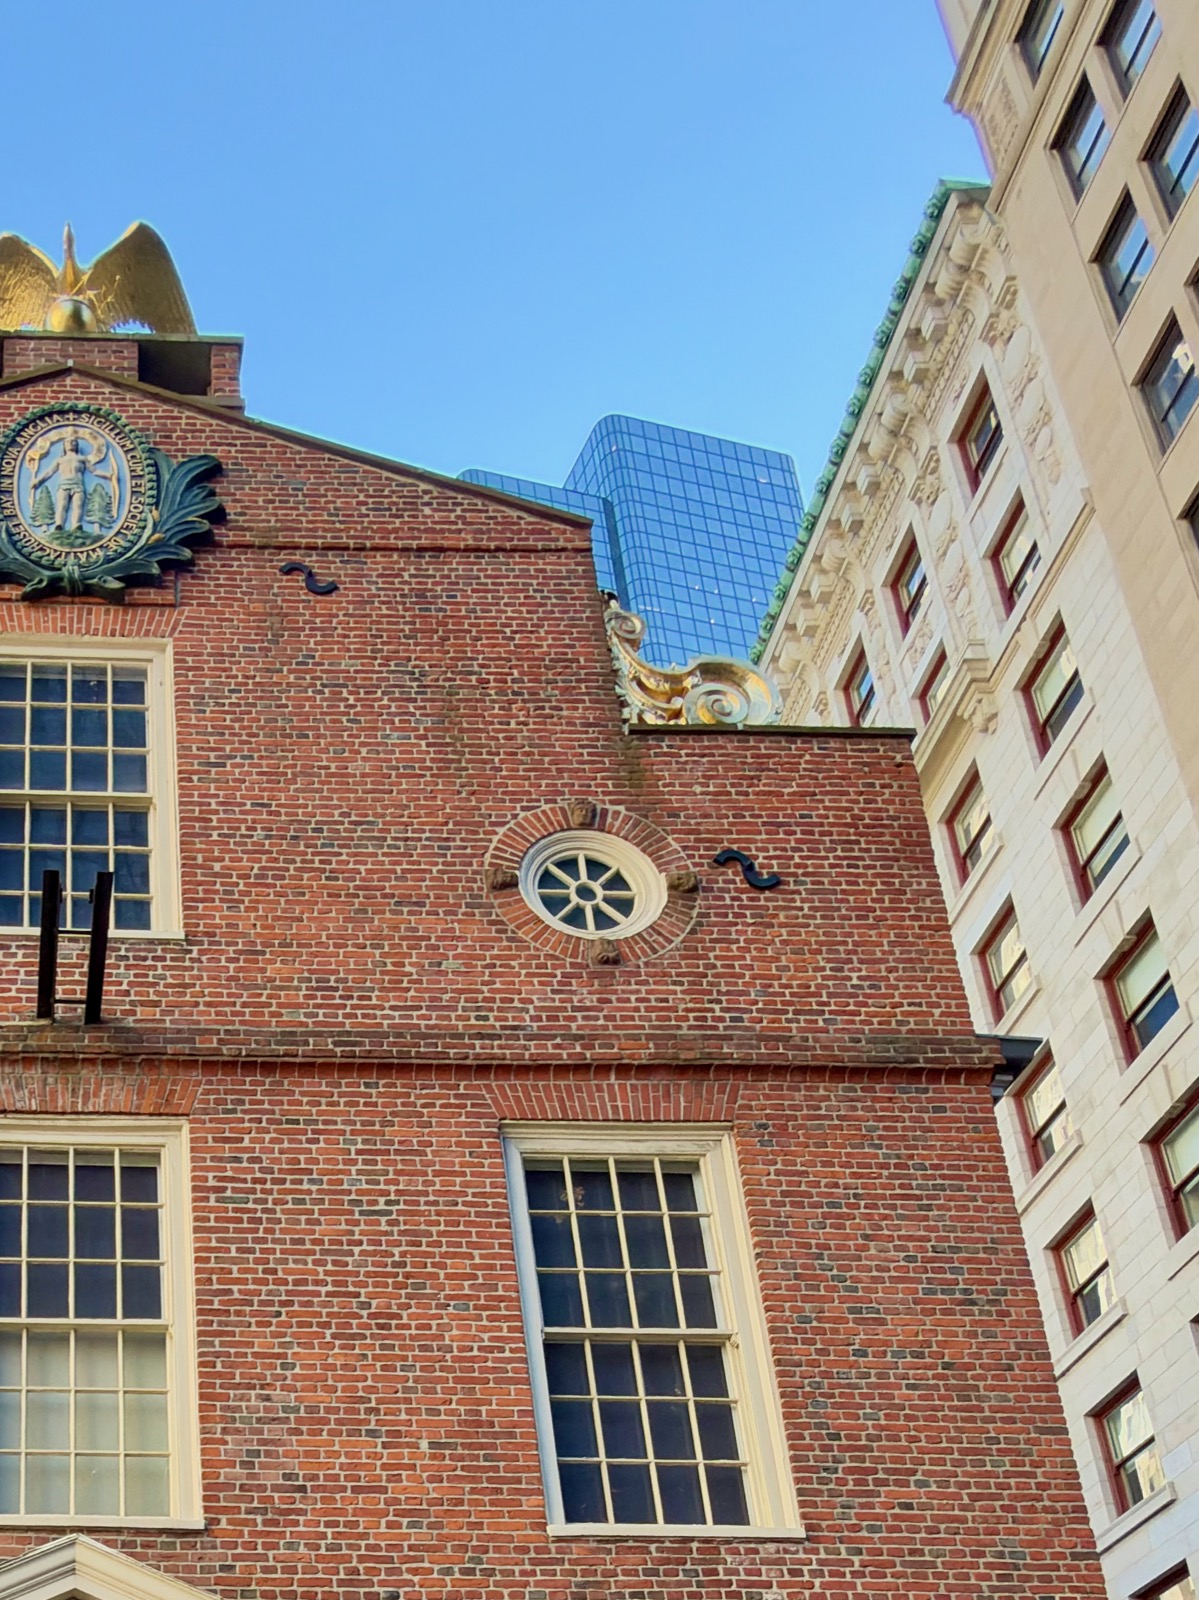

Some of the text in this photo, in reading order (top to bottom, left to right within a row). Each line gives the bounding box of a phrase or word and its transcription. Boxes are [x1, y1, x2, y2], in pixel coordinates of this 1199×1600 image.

[1, 447, 21, 476] NOVA
[0, 479, 14, 491] IN
[0, 495, 16, 516] BAY
